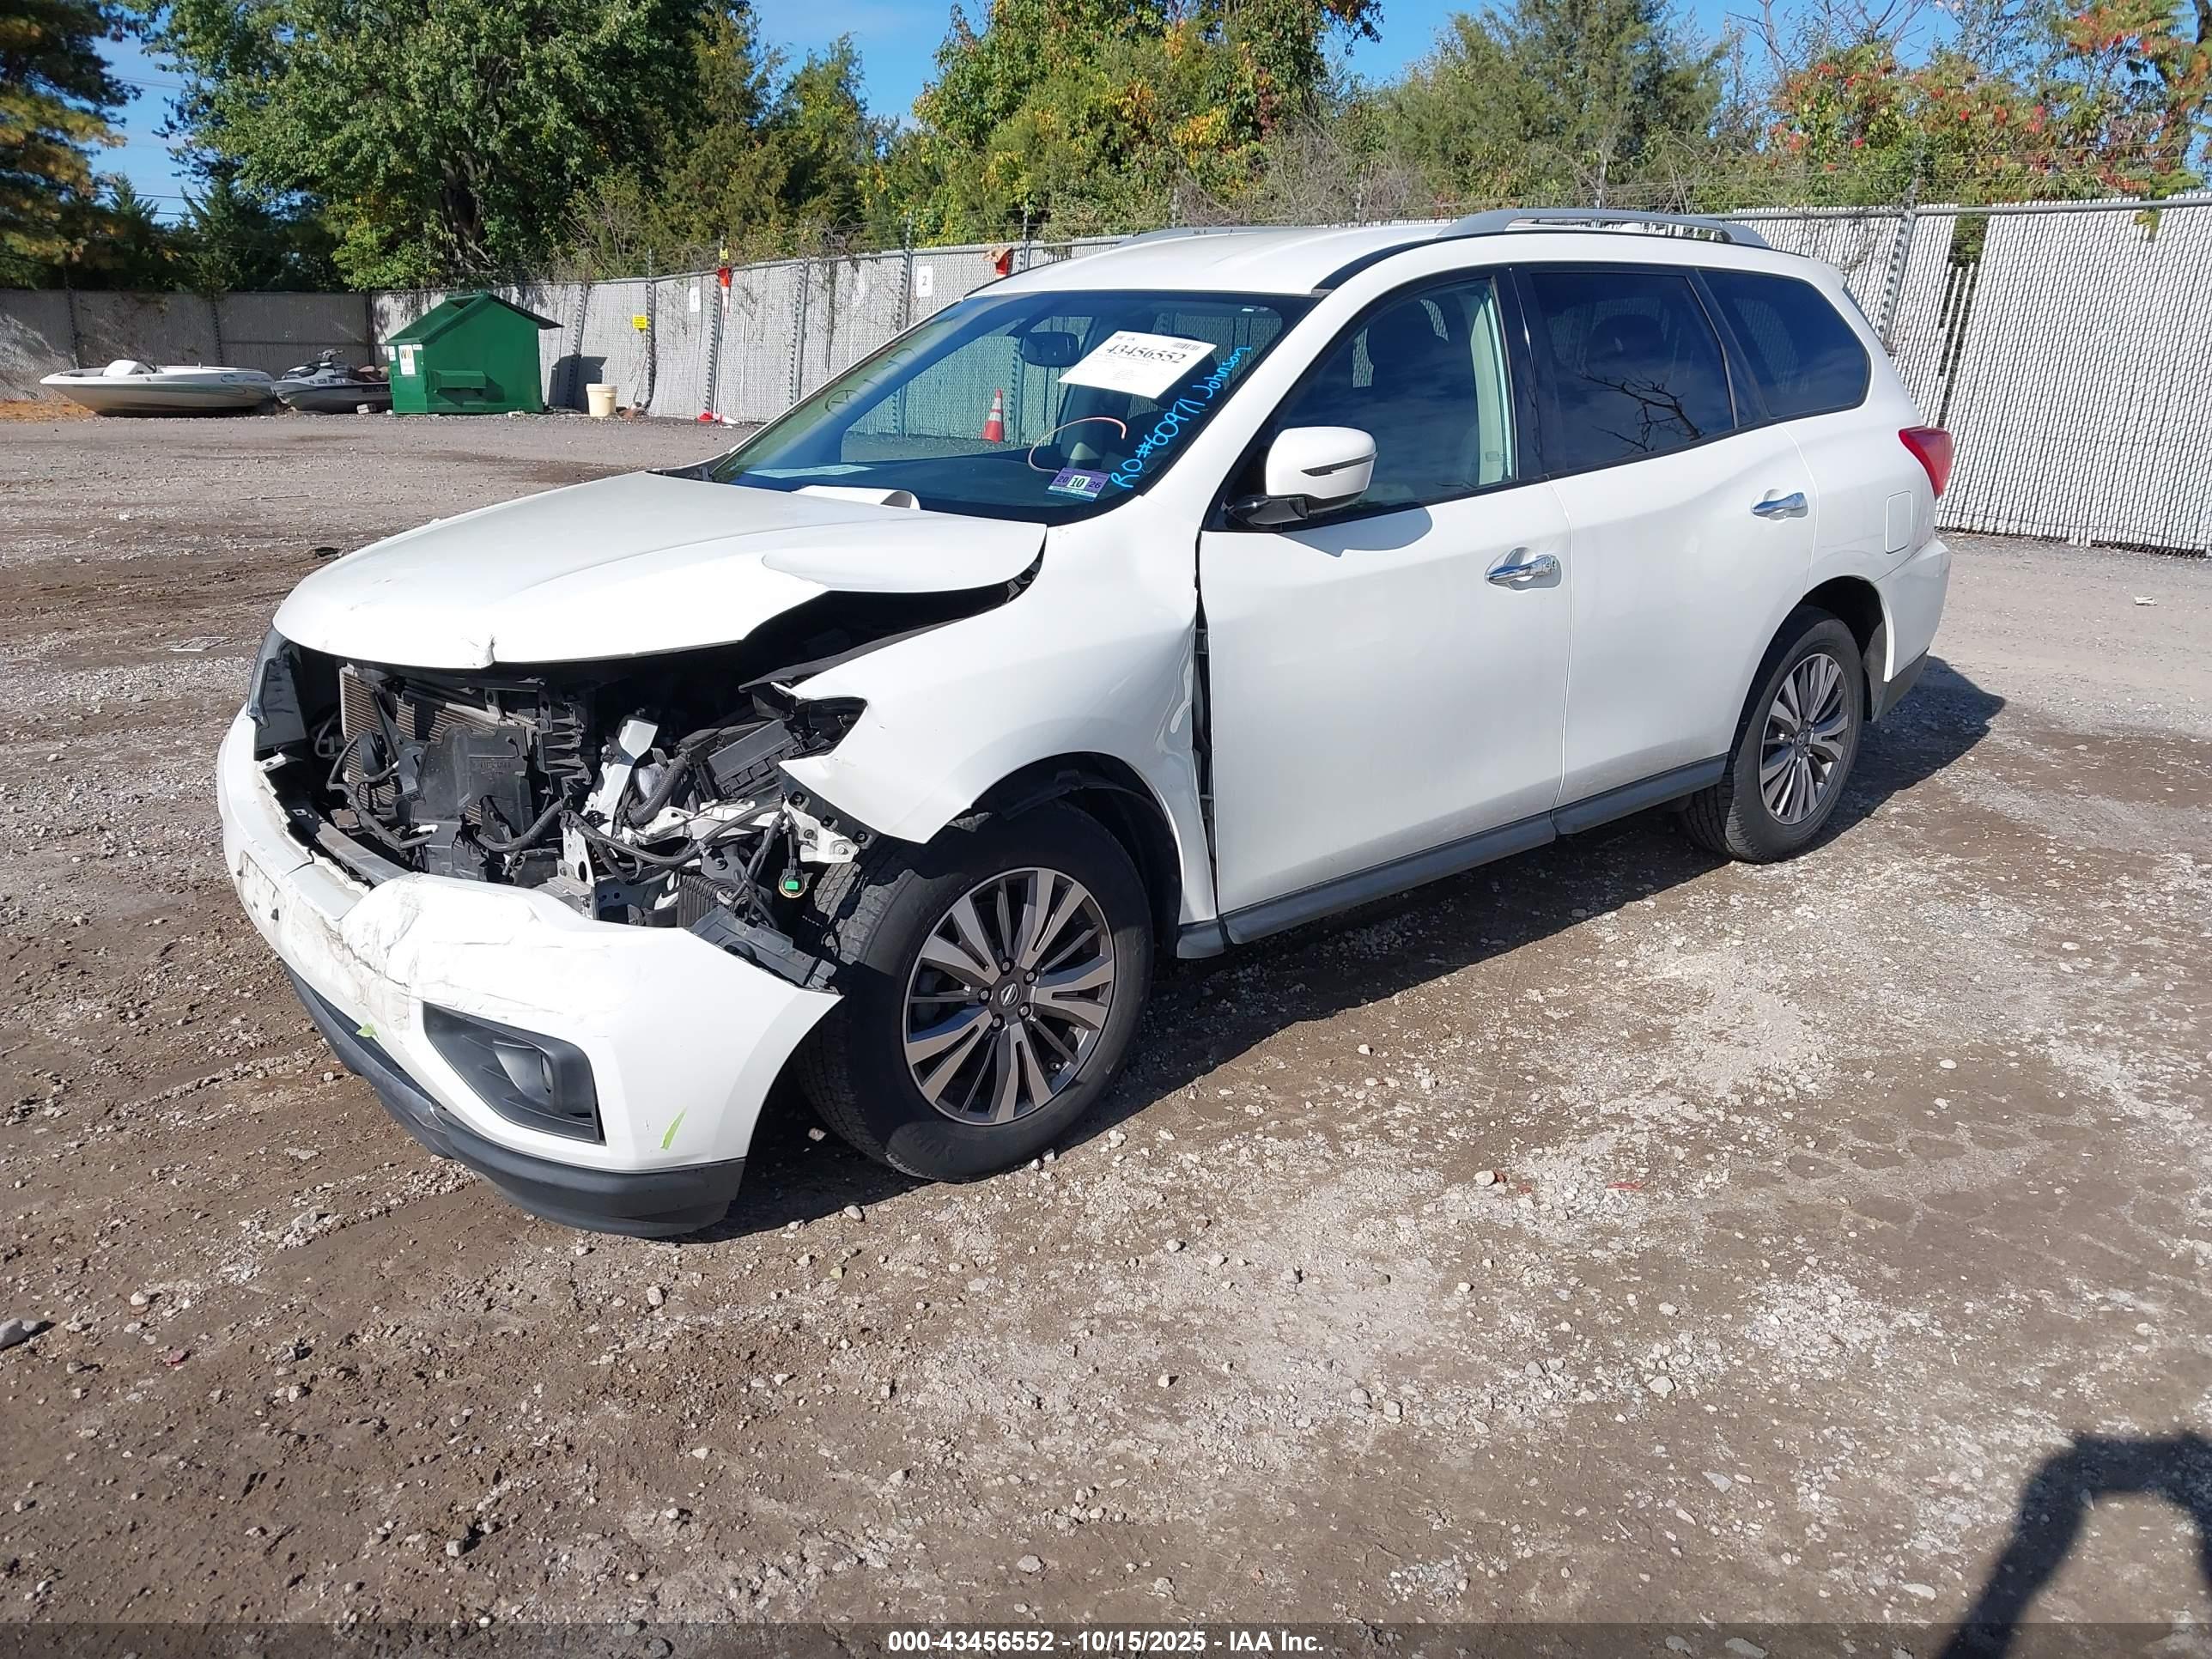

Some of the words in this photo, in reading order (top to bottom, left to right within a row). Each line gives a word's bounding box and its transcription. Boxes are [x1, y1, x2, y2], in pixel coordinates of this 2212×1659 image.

[922, 275, 927, 286] 2
[1106, 343, 1187, 363] 43456552
[1192, 346, 1252, 399] Johnson
[1057, 475, 1069, 483] 20
[1070, 477, 1085, 488] 10
